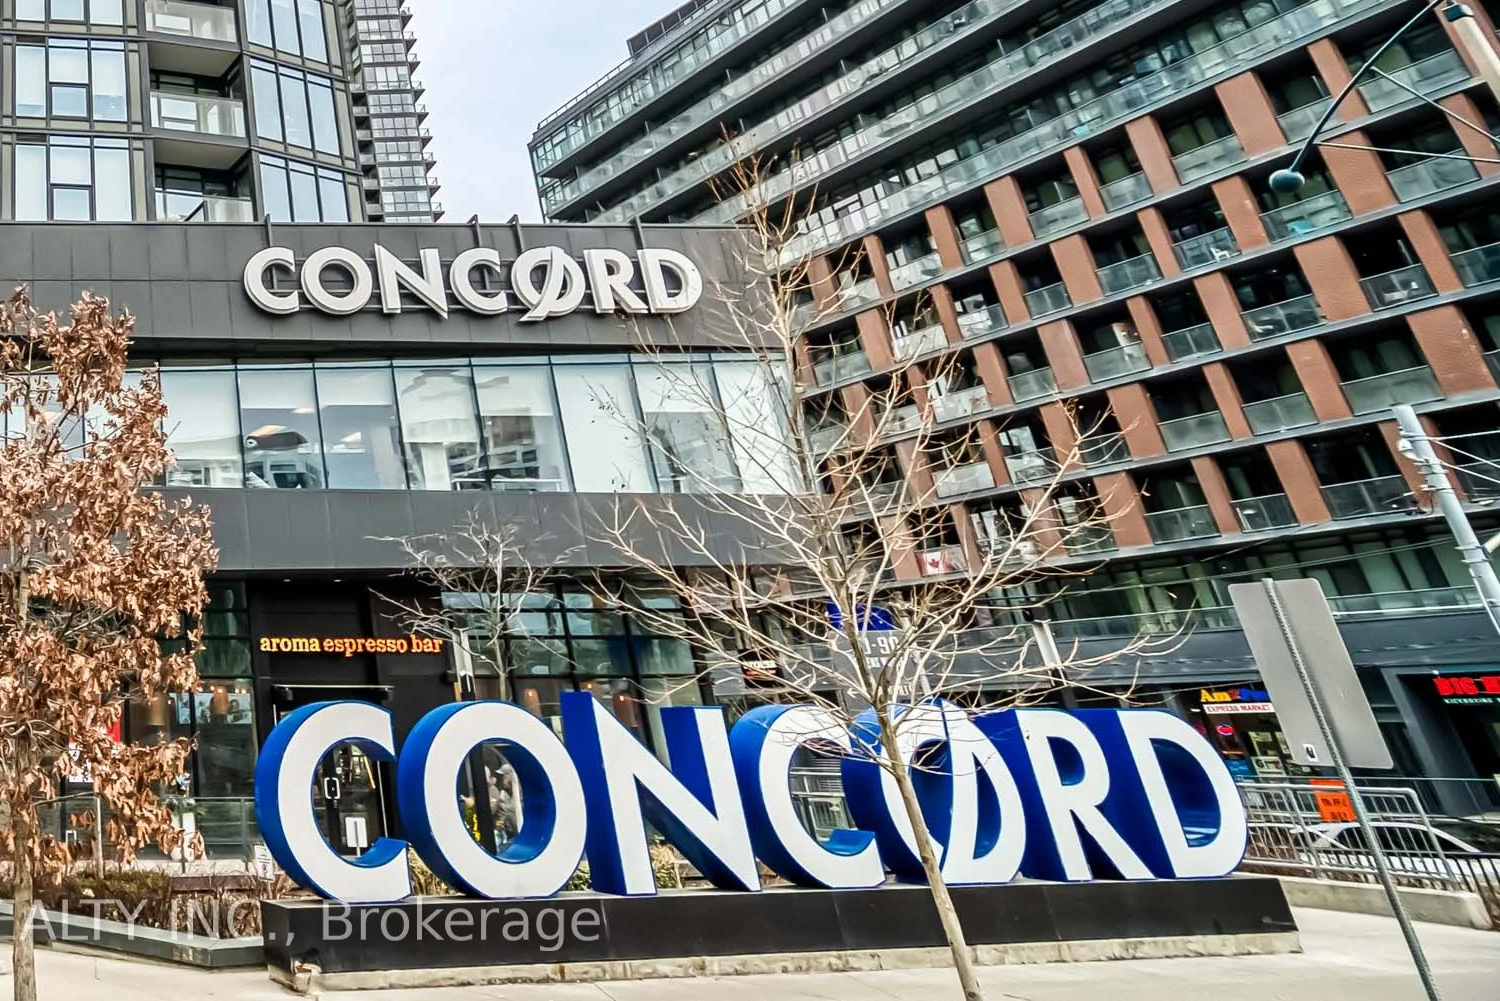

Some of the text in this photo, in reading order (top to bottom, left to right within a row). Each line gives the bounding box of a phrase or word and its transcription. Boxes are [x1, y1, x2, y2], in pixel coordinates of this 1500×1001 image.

[259, 634, 444, 657] aroma espresso bar
